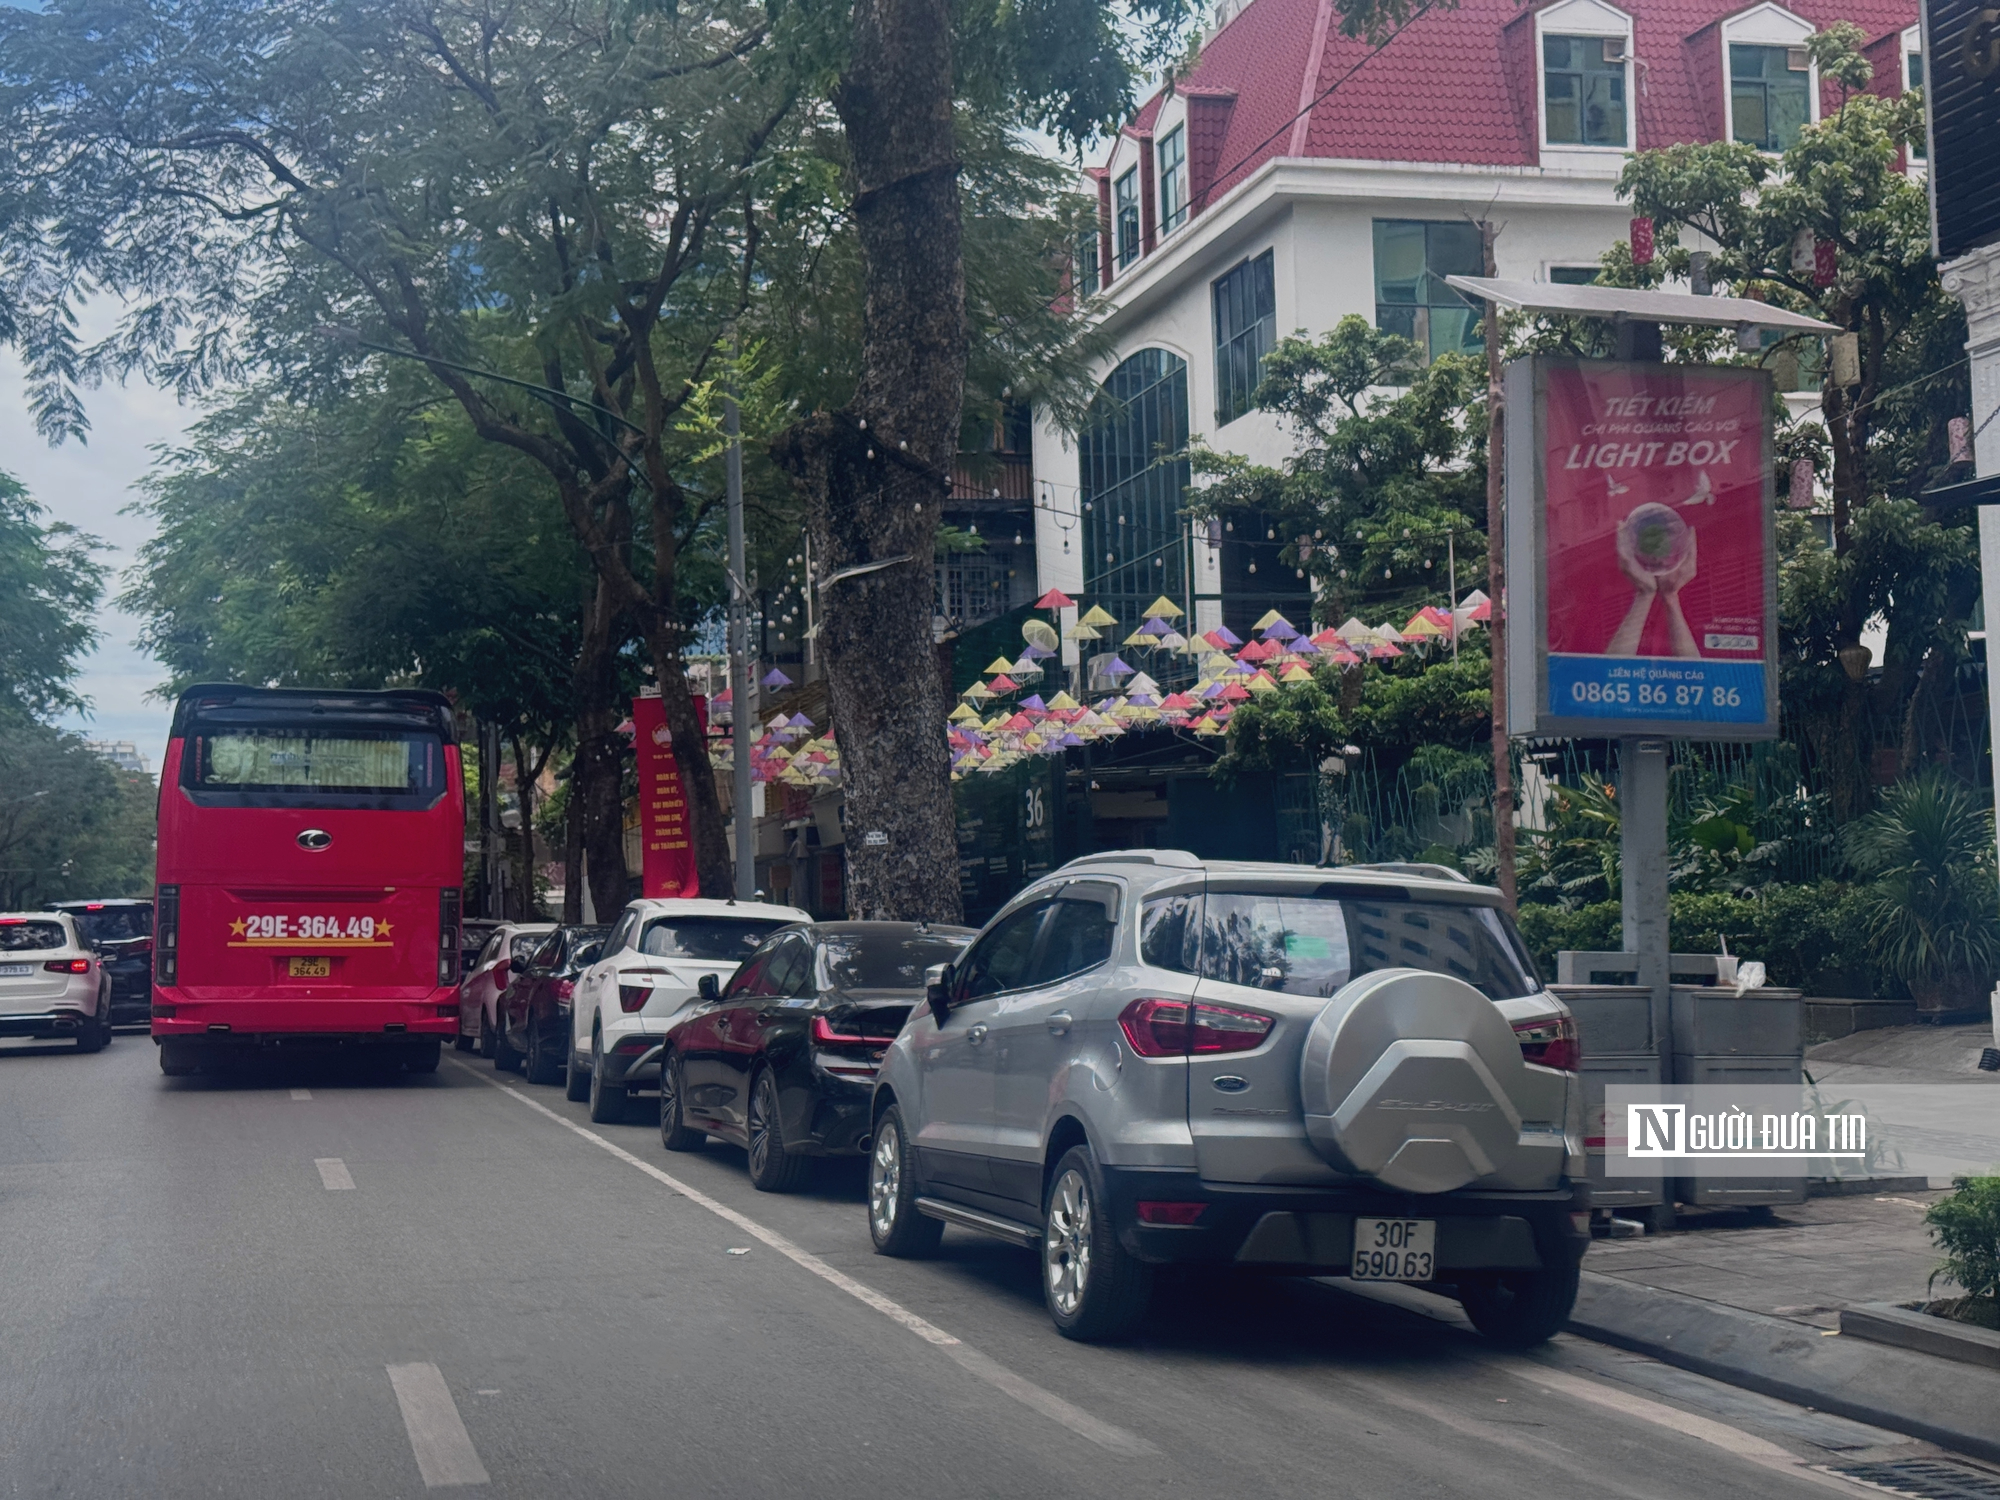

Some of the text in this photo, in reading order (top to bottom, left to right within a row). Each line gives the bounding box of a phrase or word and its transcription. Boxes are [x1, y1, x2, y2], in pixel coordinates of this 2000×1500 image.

[1605, 391, 1717, 420] TIẾT KIỆM
[1564, 439, 1741, 470] LIGHT BOX
[1608, 668, 1705, 681] LIÊN HỆ QUẢNG CÁO
[1572, 681, 1741, 707] 0865 86 87 86
[1025, 787, 1044, 828] 36
[246, 914, 375, 939] 29E-364.49
[293, 967, 326, 976] 364.49
[1374, 1221, 1418, 1249] 30F
[1355, 1250, 1432, 1278] 590.63
